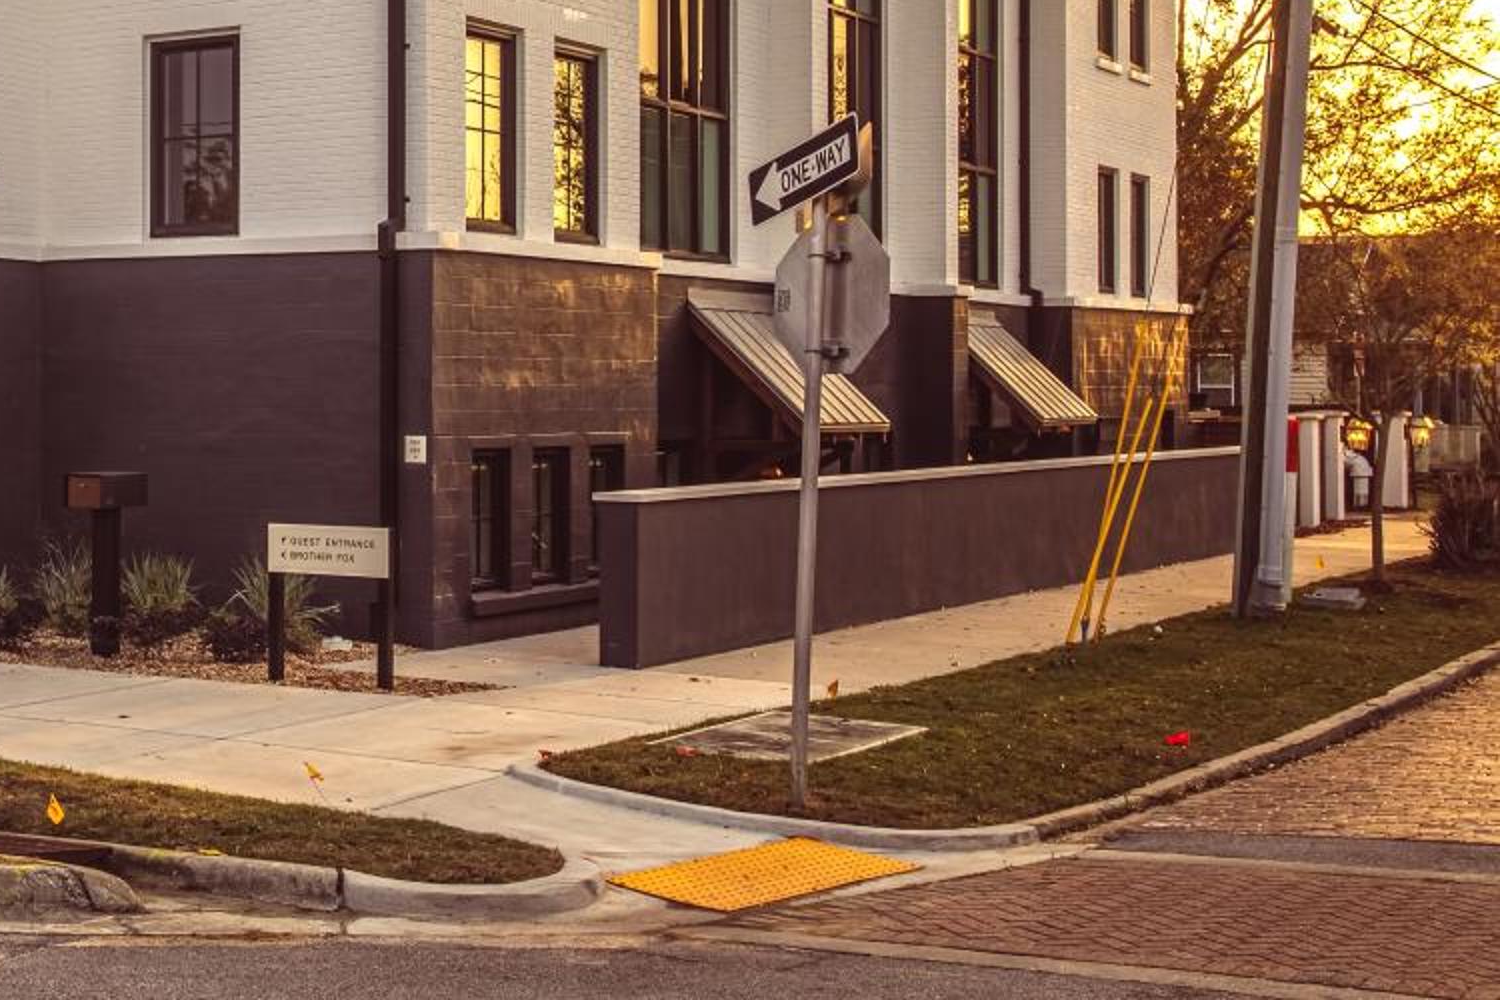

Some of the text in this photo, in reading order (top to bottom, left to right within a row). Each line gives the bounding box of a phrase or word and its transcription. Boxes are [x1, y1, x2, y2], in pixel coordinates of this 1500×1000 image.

[781, 138, 845, 193] ONE WAY
[289, 536, 375, 549] GUEST ENTRANCE
